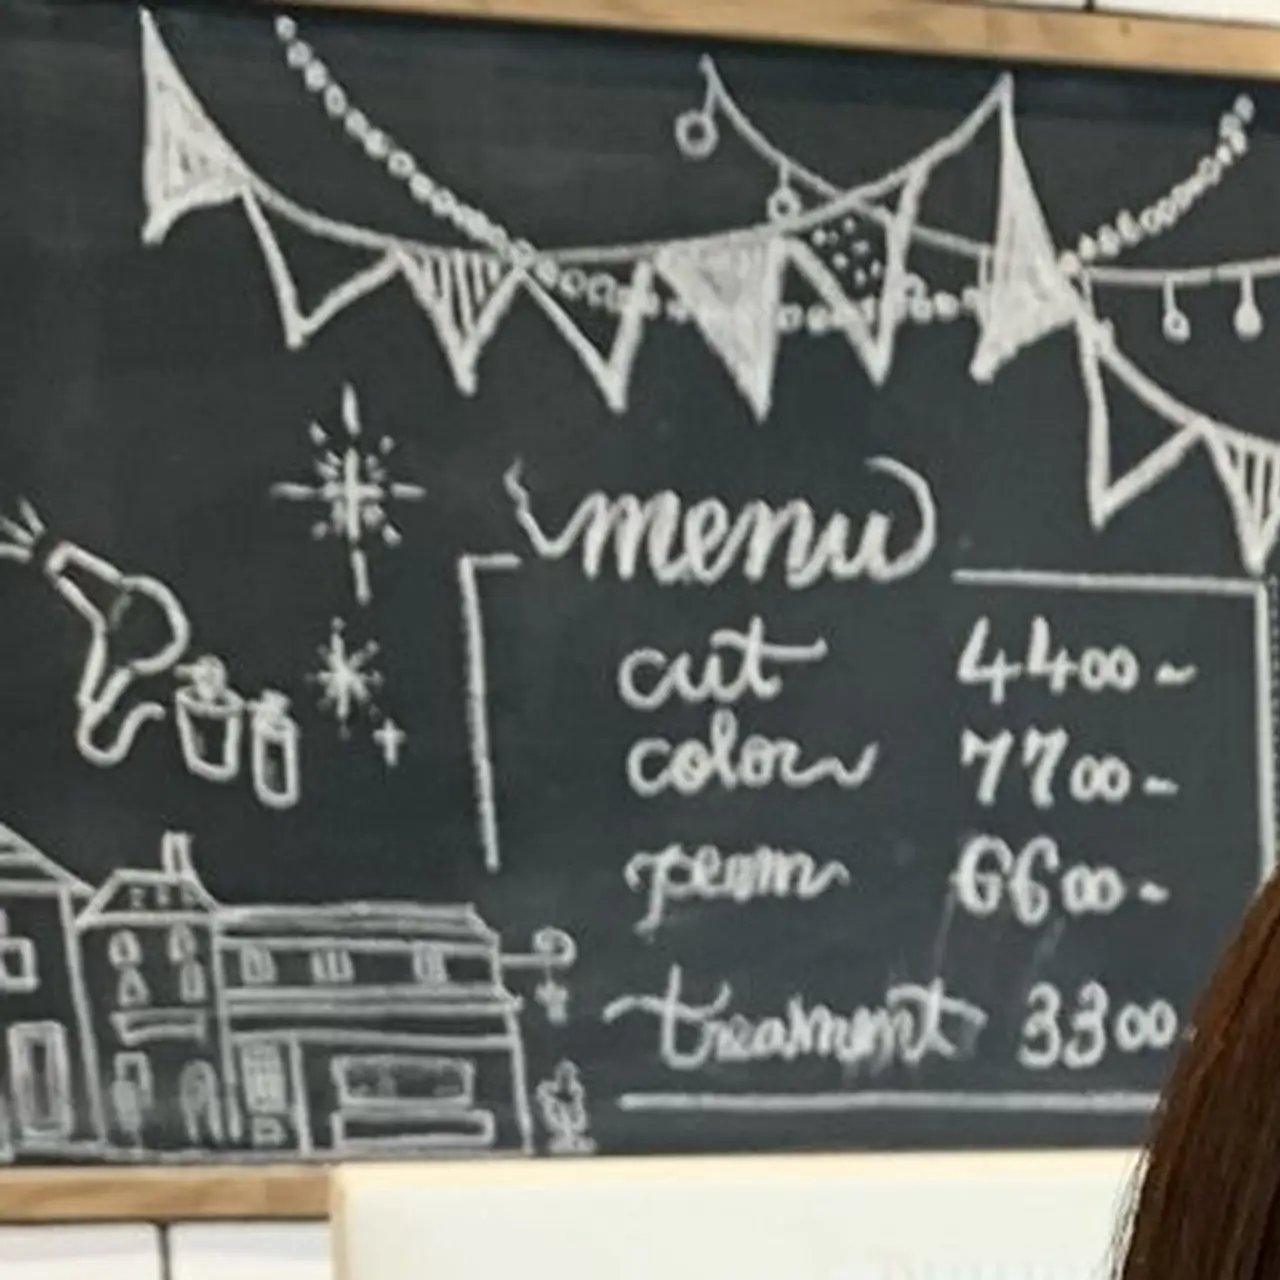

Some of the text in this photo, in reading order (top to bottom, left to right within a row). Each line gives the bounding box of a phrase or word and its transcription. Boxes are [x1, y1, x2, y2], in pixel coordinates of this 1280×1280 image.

[503, 455, 937, 588] menu
[617, 614, 829, 709] cut
[626, 708, 879, 797] color
[623, 842, 851, 936] perm
